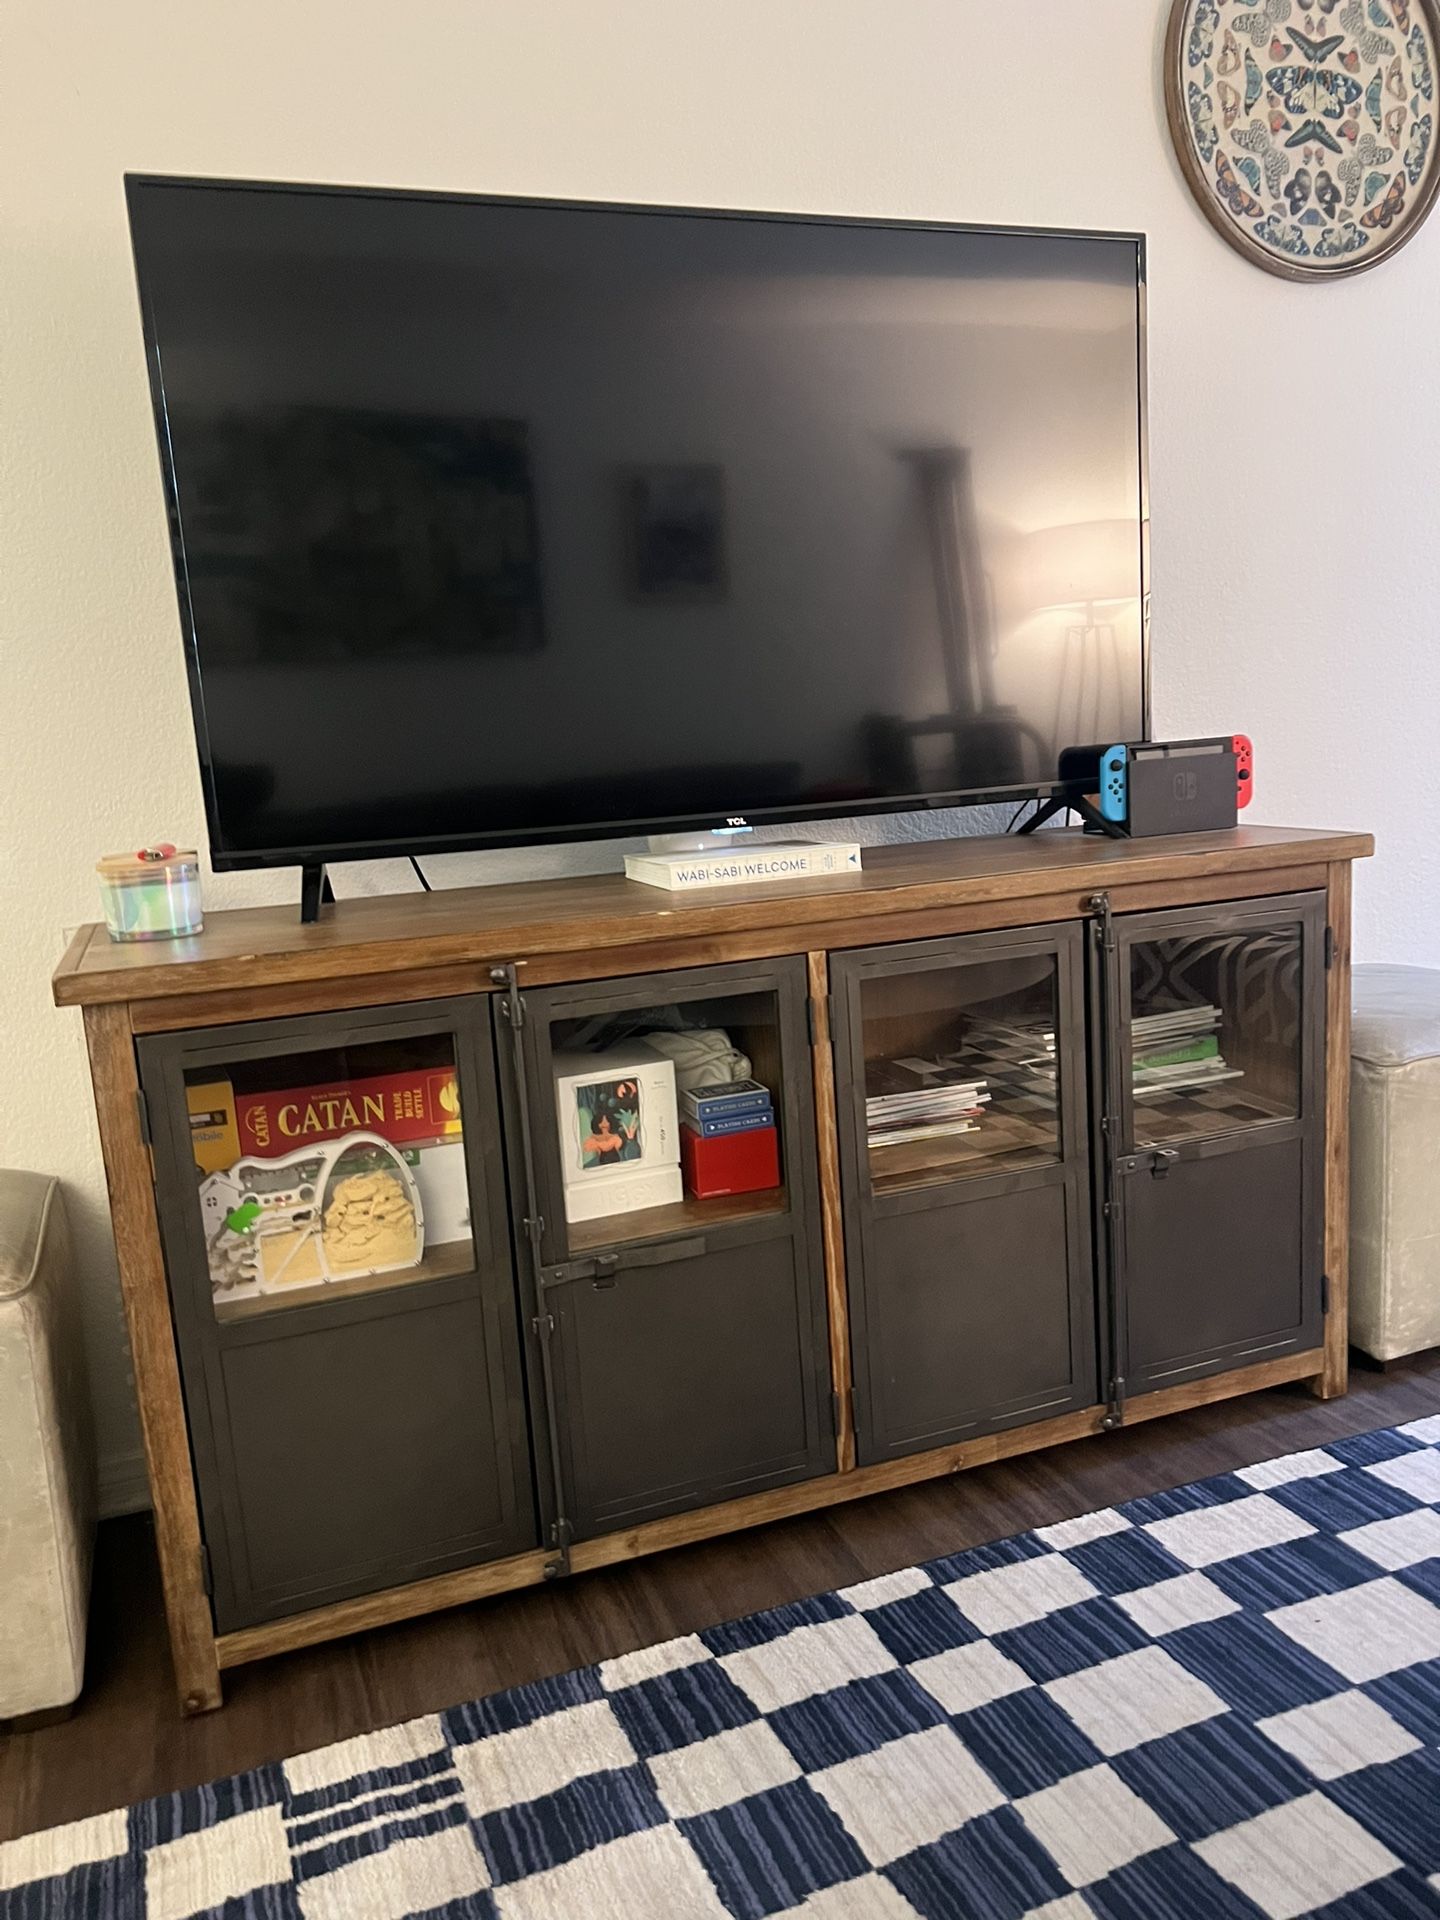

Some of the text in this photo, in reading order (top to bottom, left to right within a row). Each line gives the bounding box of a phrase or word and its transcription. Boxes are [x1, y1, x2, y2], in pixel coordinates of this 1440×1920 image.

[726, 817, 747, 826] TCL
[677, 866, 742, 883] WABI-SABI
[744, 858, 807, 875] WELCOME
[255, 1105, 270, 1147] CATAN
[278, 1093, 386, 1137] CATAN
